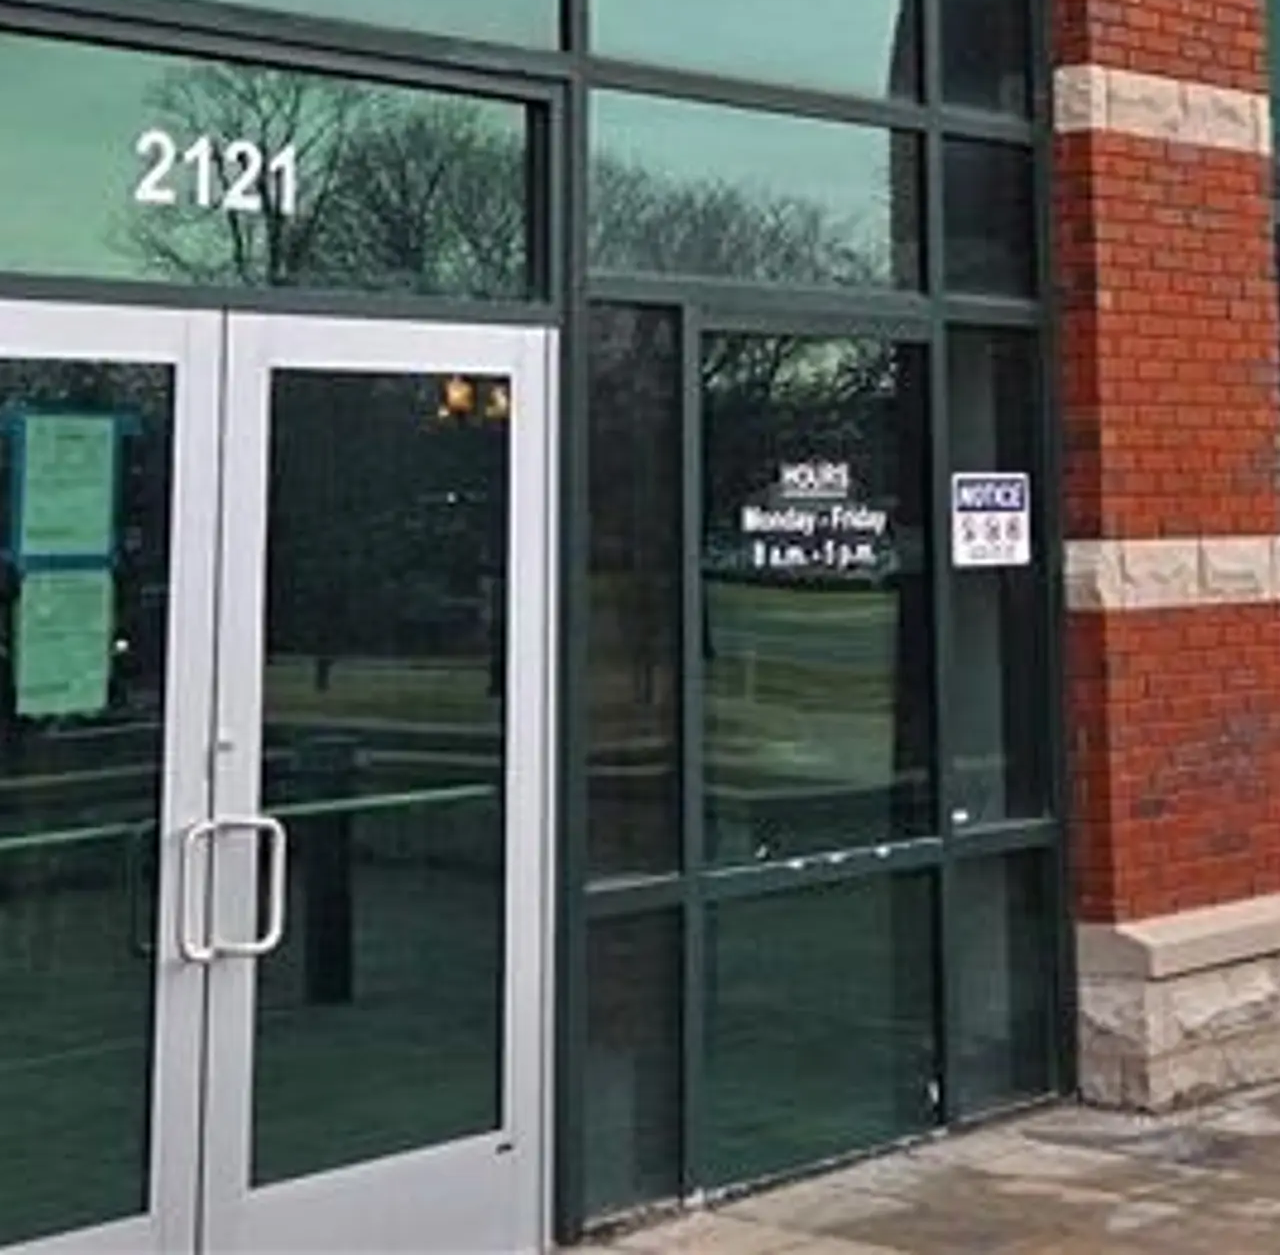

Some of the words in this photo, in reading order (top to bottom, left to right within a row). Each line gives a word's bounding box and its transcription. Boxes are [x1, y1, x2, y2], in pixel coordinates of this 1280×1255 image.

[134, 129, 296, 215] 2121
[780, 461, 849, 489] HOURS
[960, 482, 1023, 508] NOTICE
[741, 505, 816, 535] Monday
[830, 505, 887, 535] Friday
